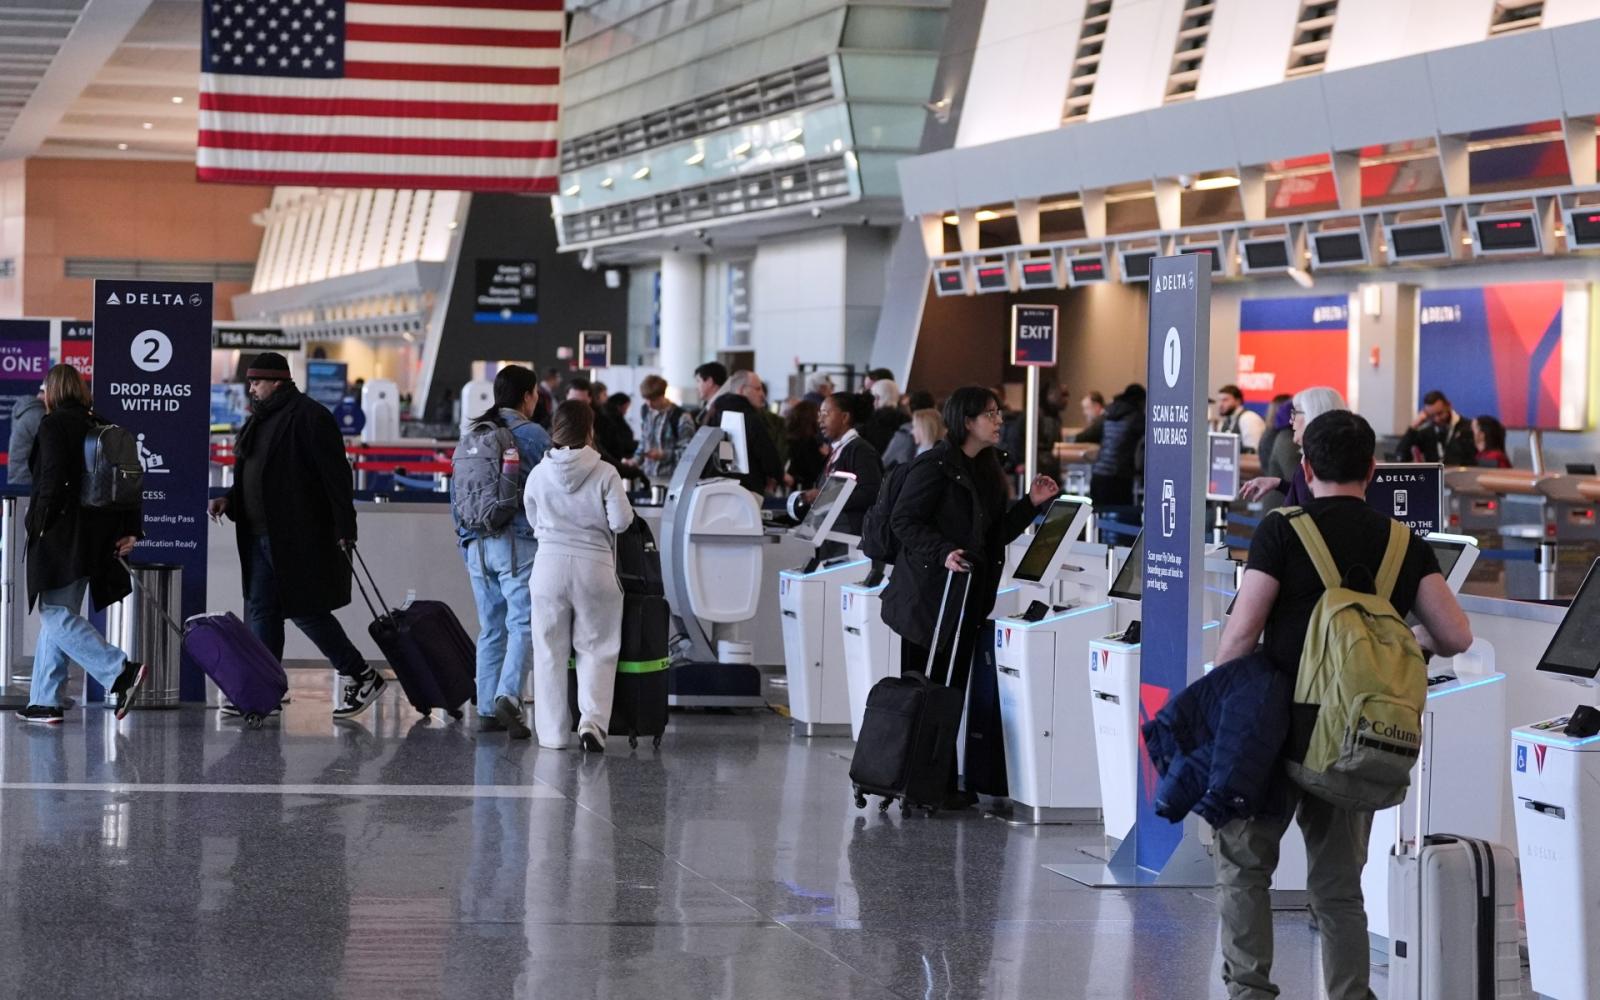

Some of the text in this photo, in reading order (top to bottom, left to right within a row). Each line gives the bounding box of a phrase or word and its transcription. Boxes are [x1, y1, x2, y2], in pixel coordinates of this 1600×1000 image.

[1163, 273, 1187, 291] DELTA
[126, 293, 184, 306] DELTA
[1429, 306, 1454, 323] DELTA
[1020, 325, 1052, 340] EXIT
[142, 338, 160, 363] 2
[584, 343, 606, 354] EXIT
[1169, 339, 1175, 375] 1
[2, 356, 42, 372] ONE
[110, 383, 192, 397] DROP BAGS
[121, 399, 180, 412] WITH ID
[1152, 405, 1189, 423] SCAN & TAG
[1153, 427, 1188, 445] YOUR BAGS
[142, 491, 166, 500] CESS:
[144, 515, 195, 524] Boarding Pass
[175, 540, 197, 549] Ready
[1147, 550, 1156, 560] Scan
[1167, 552, 1175, 563] Delta
[1147, 564, 1161, 577] boarding
[1147, 578, 1155, 589] print
